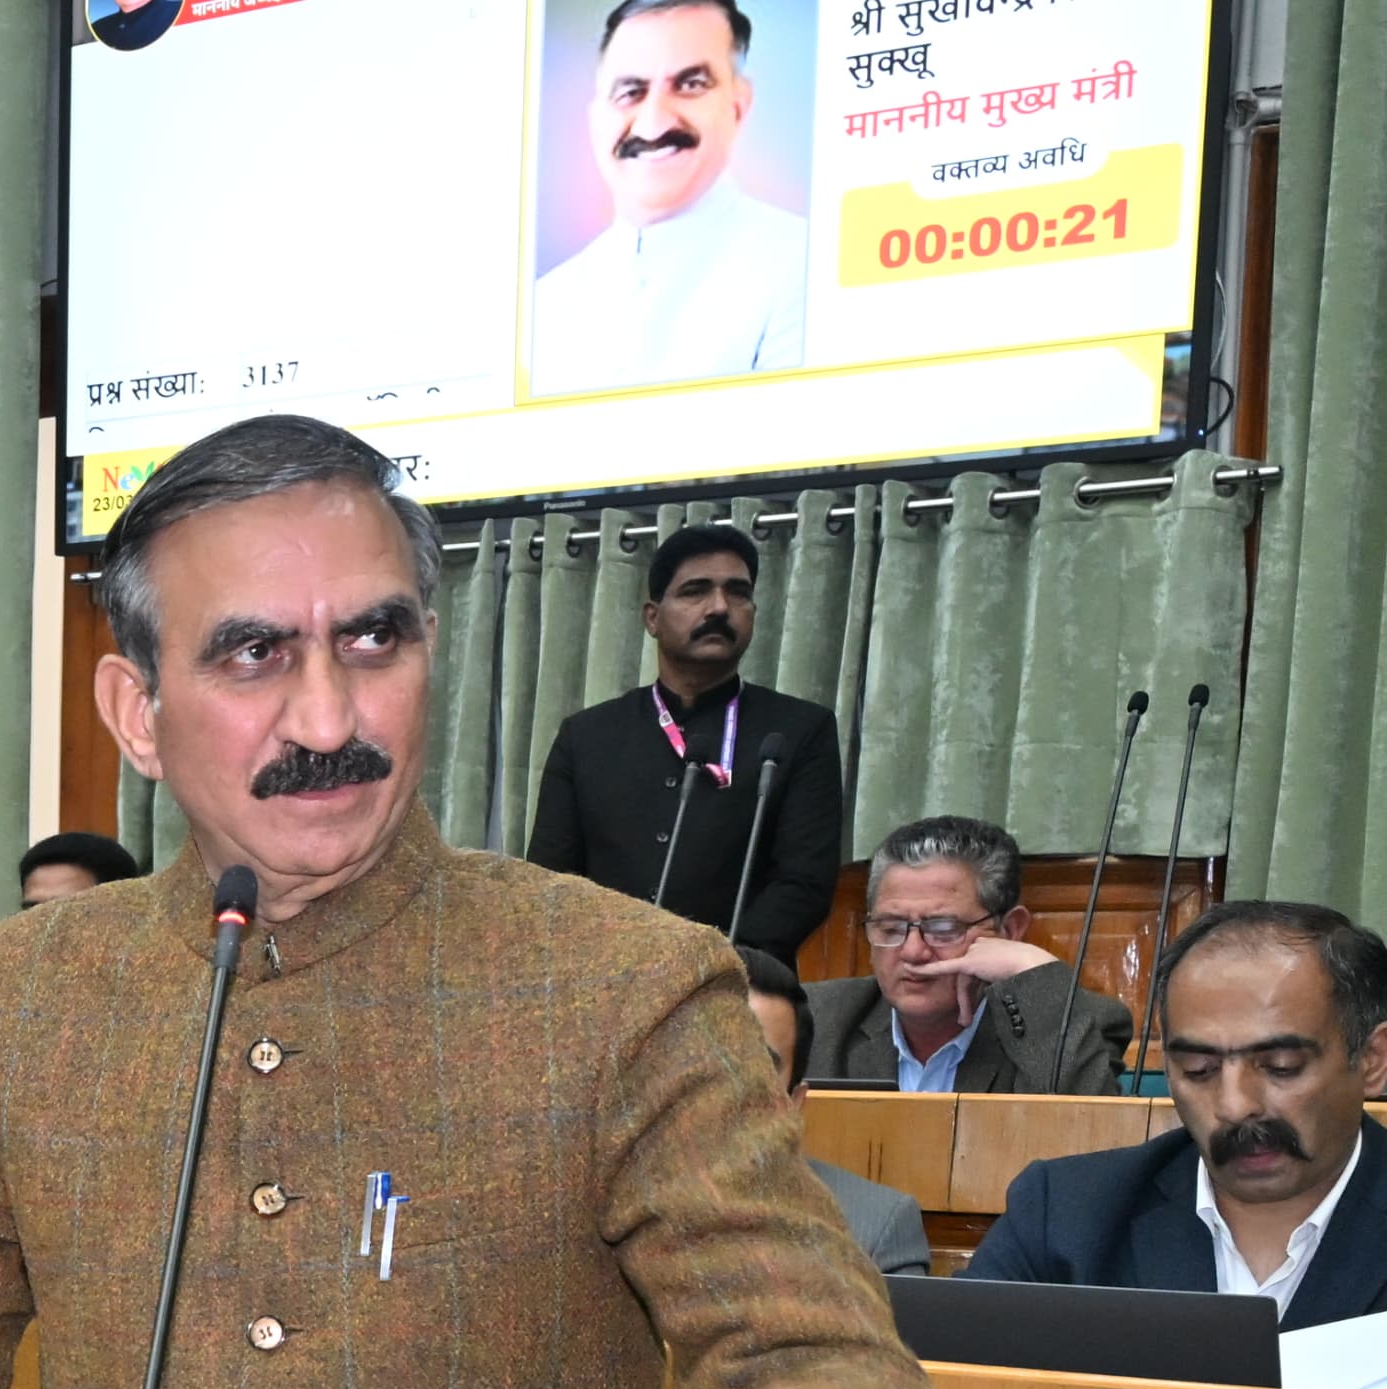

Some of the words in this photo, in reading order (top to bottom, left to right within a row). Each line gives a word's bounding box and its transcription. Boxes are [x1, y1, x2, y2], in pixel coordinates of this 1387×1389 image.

[846, 43, 935, 89] सुक्खू
[844, 90, 971, 139] माननीय
[980, 82, 1061, 128] मुख्य
[1071, 60, 1138, 104] मंत्री
[930, 154, 1010, 183] वक्तव्य
[1017, 137, 1088, 171] अवधि
[878, 198, 1129, 269] 00:00:21
[87, 381, 124, 407] प्रश्न
[242, 360, 300, 388] 3137
